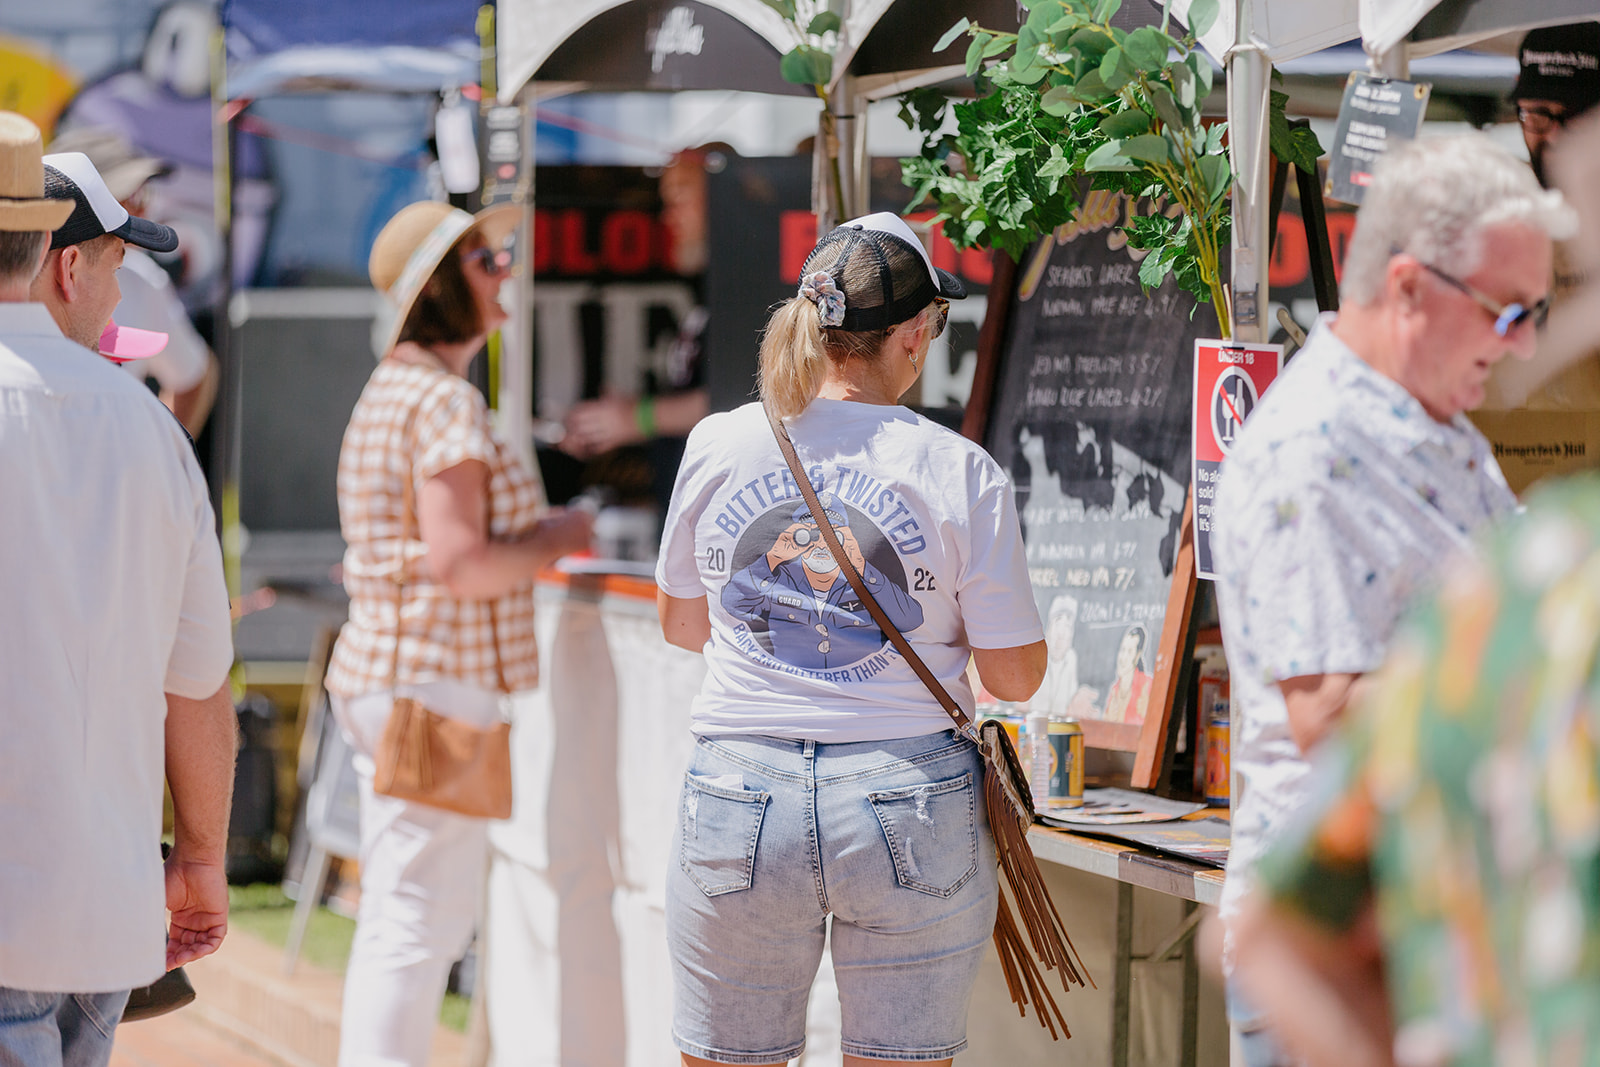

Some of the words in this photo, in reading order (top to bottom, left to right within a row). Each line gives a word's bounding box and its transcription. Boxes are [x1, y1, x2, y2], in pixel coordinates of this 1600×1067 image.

[1218, 350, 1244, 364] UNDER
[1245, 352, 1255, 365] 18
[1198, 468, 1209, 482] No
[1198, 486, 1214, 499] sold
[714, 468, 802, 539] BITTER
[809, 464, 825, 495] &
[836, 465, 927, 556] TWISTED
[706, 546, 726, 573] 20
[914, 567, 937, 591] 22
[778, 595, 802, 608] GUARD
[852, 654, 890, 683] THAN
